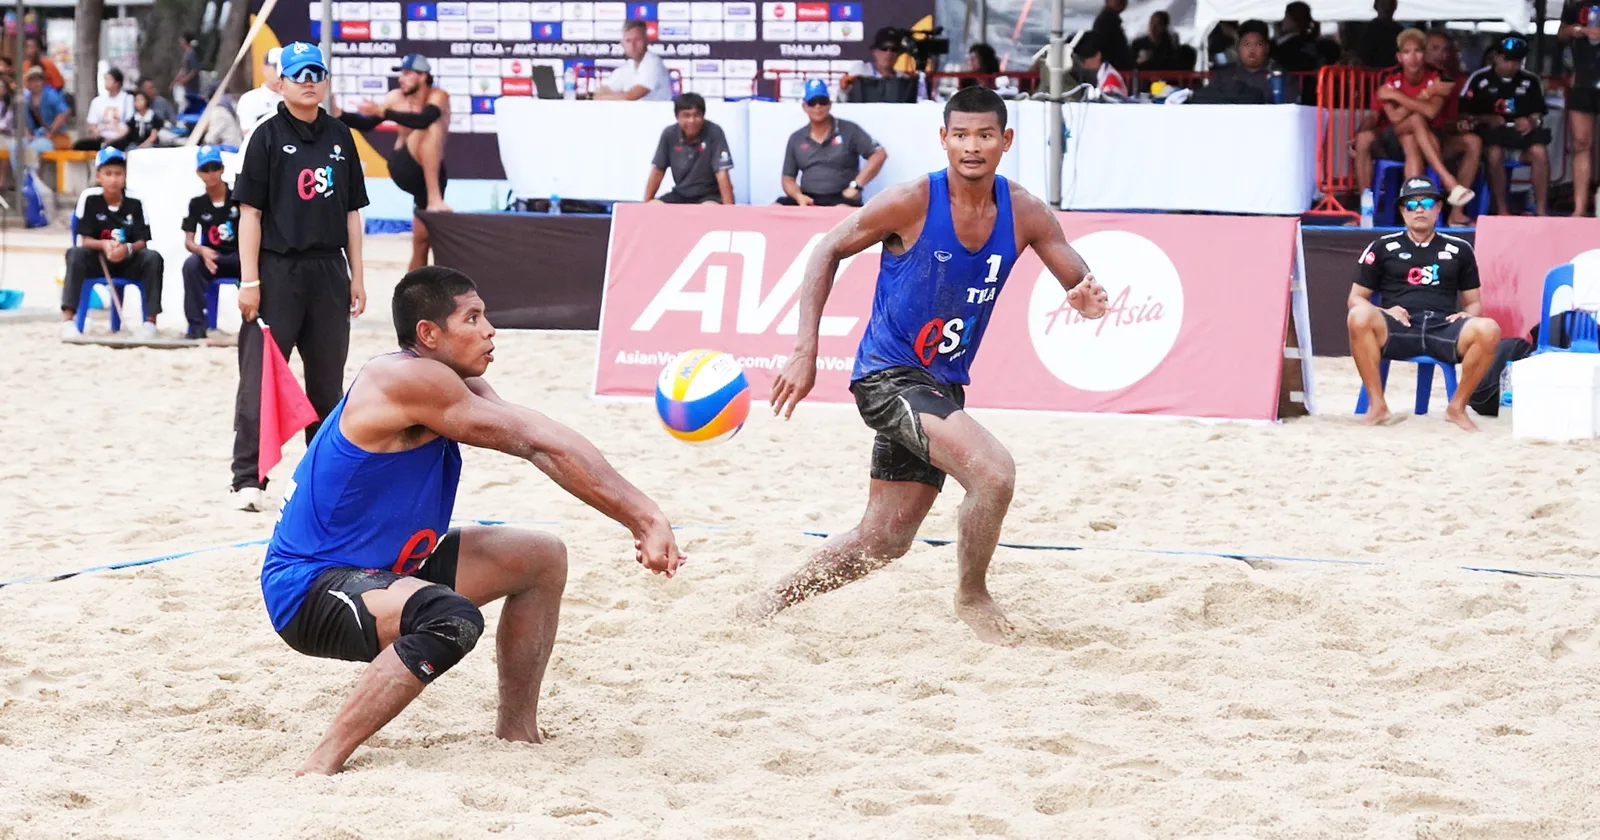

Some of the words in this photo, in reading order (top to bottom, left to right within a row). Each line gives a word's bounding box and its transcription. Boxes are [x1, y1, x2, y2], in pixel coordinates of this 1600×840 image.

[359, 43, 396, 54] BEACH
[473, 43, 505, 55] COLA
[537, 43, 577, 55] BEACH
[578, 43, 610, 55] TOUR
[677, 44, 710, 55] OPEN
[780, 44, 841, 56] THAILAND
[298, 166, 333, 200] est
[208, 220, 234, 246] est
[984, 254, 1002, 283] 1
[1407, 263, 1440, 286] est
[914, 316, 976, 367] est
